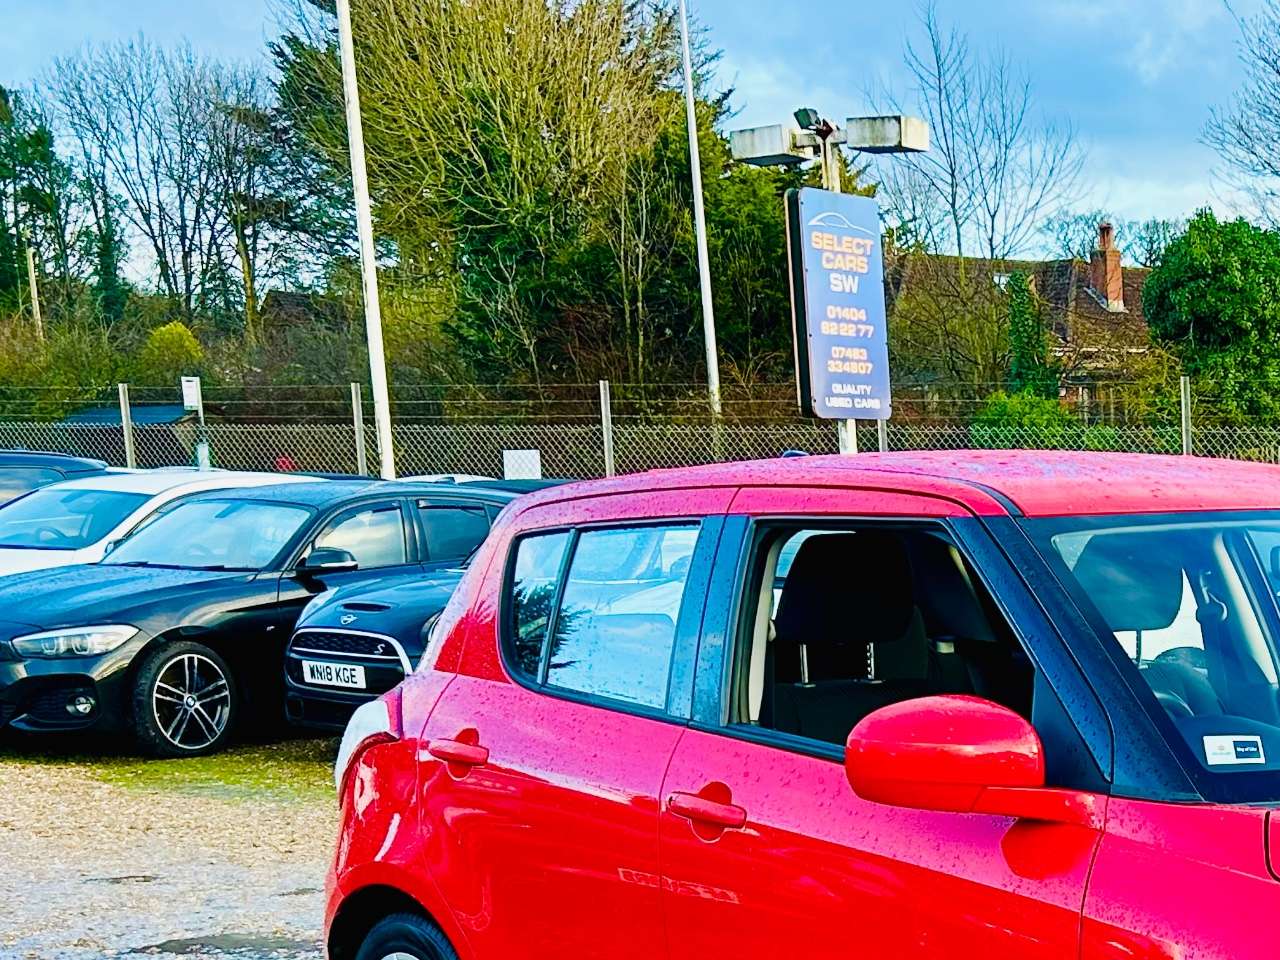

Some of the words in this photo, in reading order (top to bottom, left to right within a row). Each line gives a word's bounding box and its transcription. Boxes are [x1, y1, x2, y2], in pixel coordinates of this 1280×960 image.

[811, 231, 874, 256] SELECT
[822, 252, 868, 273] CARS
[830, 272, 859, 294] SW
[826, 305, 867, 321] 01404
[821, 321, 838, 335] 82
[839, 322, 856, 336] 22
[857, 324, 874, 338] 77
[832, 383, 872, 395] QUALITY
[825, 396, 852, 408] USED
[854, 398, 880, 409] CARS
[308, 664, 333, 682] WN18
[335, 667, 358, 684] KGE
